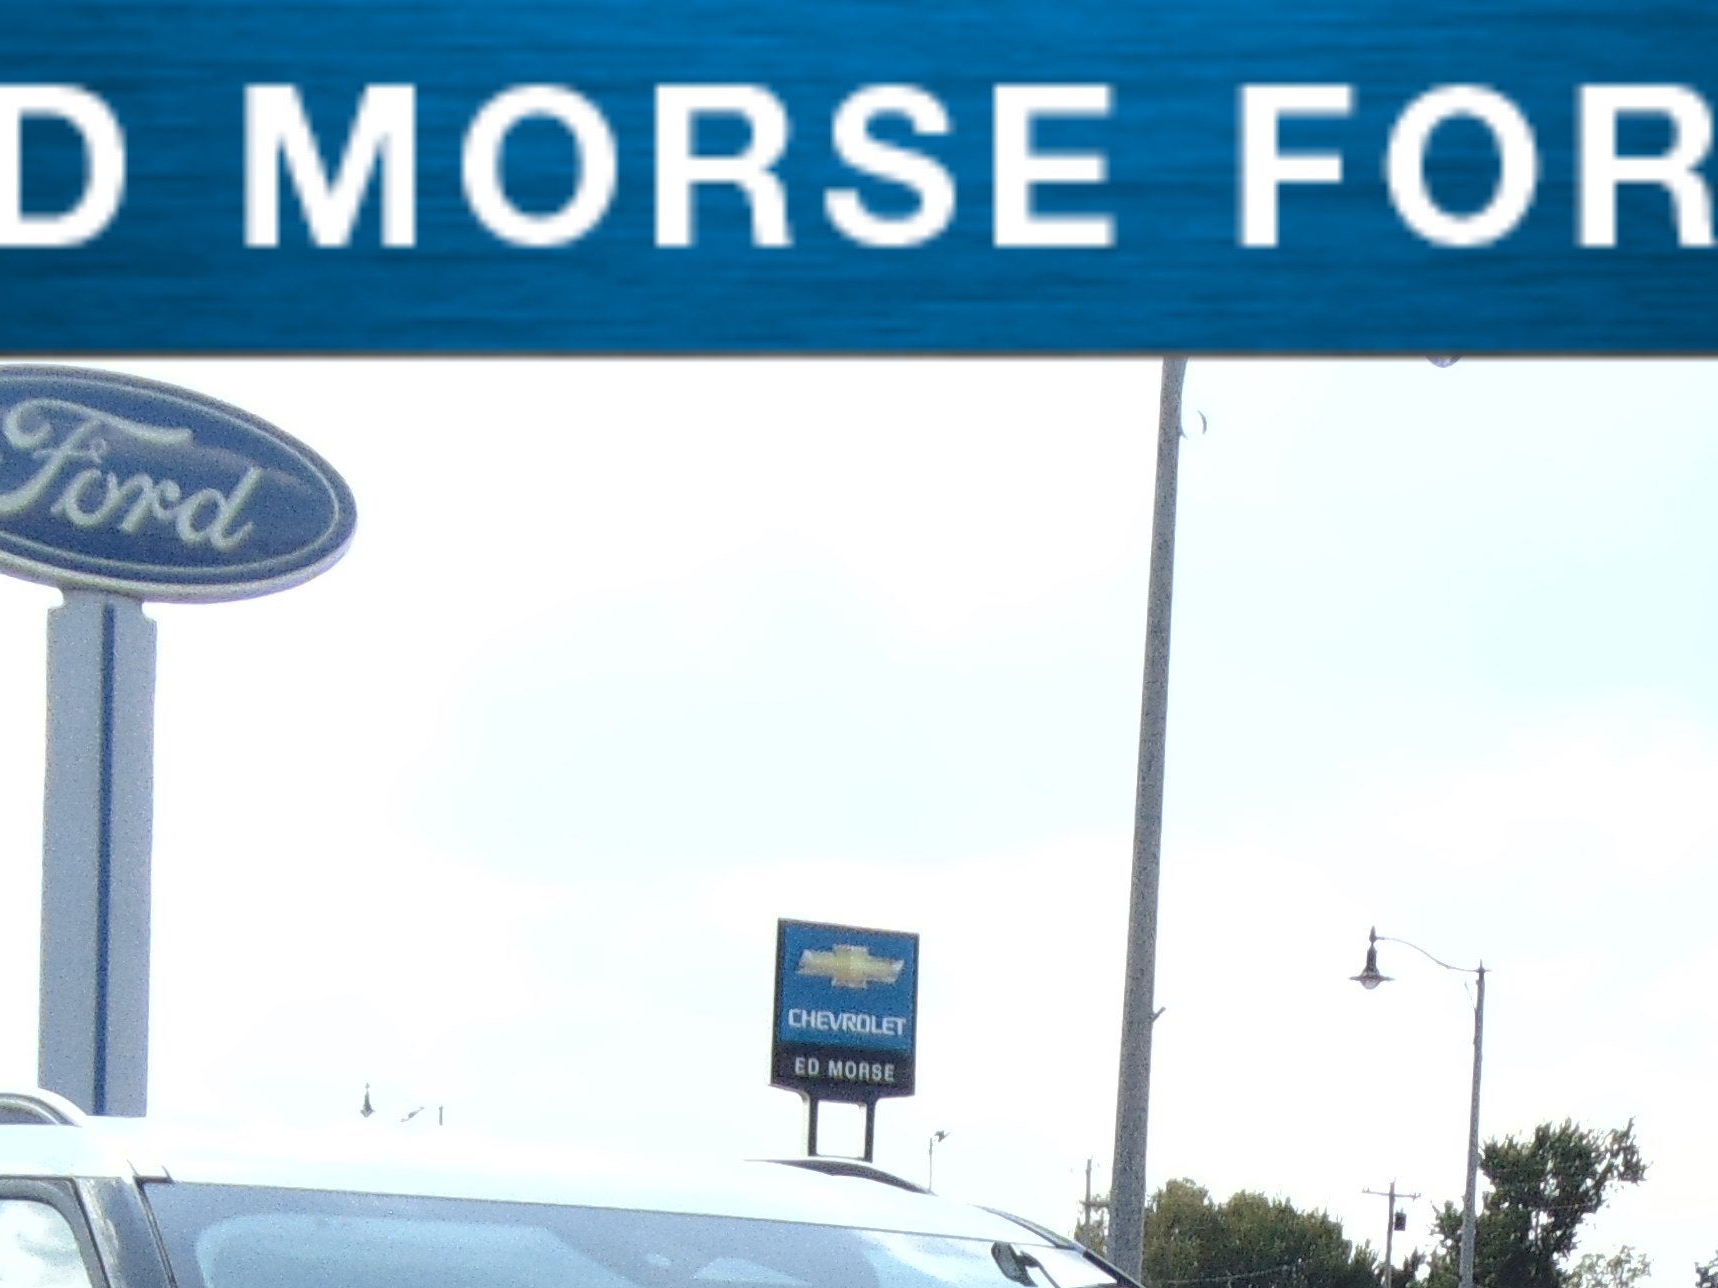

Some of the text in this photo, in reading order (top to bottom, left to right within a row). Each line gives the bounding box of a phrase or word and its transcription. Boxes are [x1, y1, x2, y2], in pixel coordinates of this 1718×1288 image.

[788, 1008, 907, 1035] CHEVROLET
[794, 1057, 895, 1082] ED MORSE
